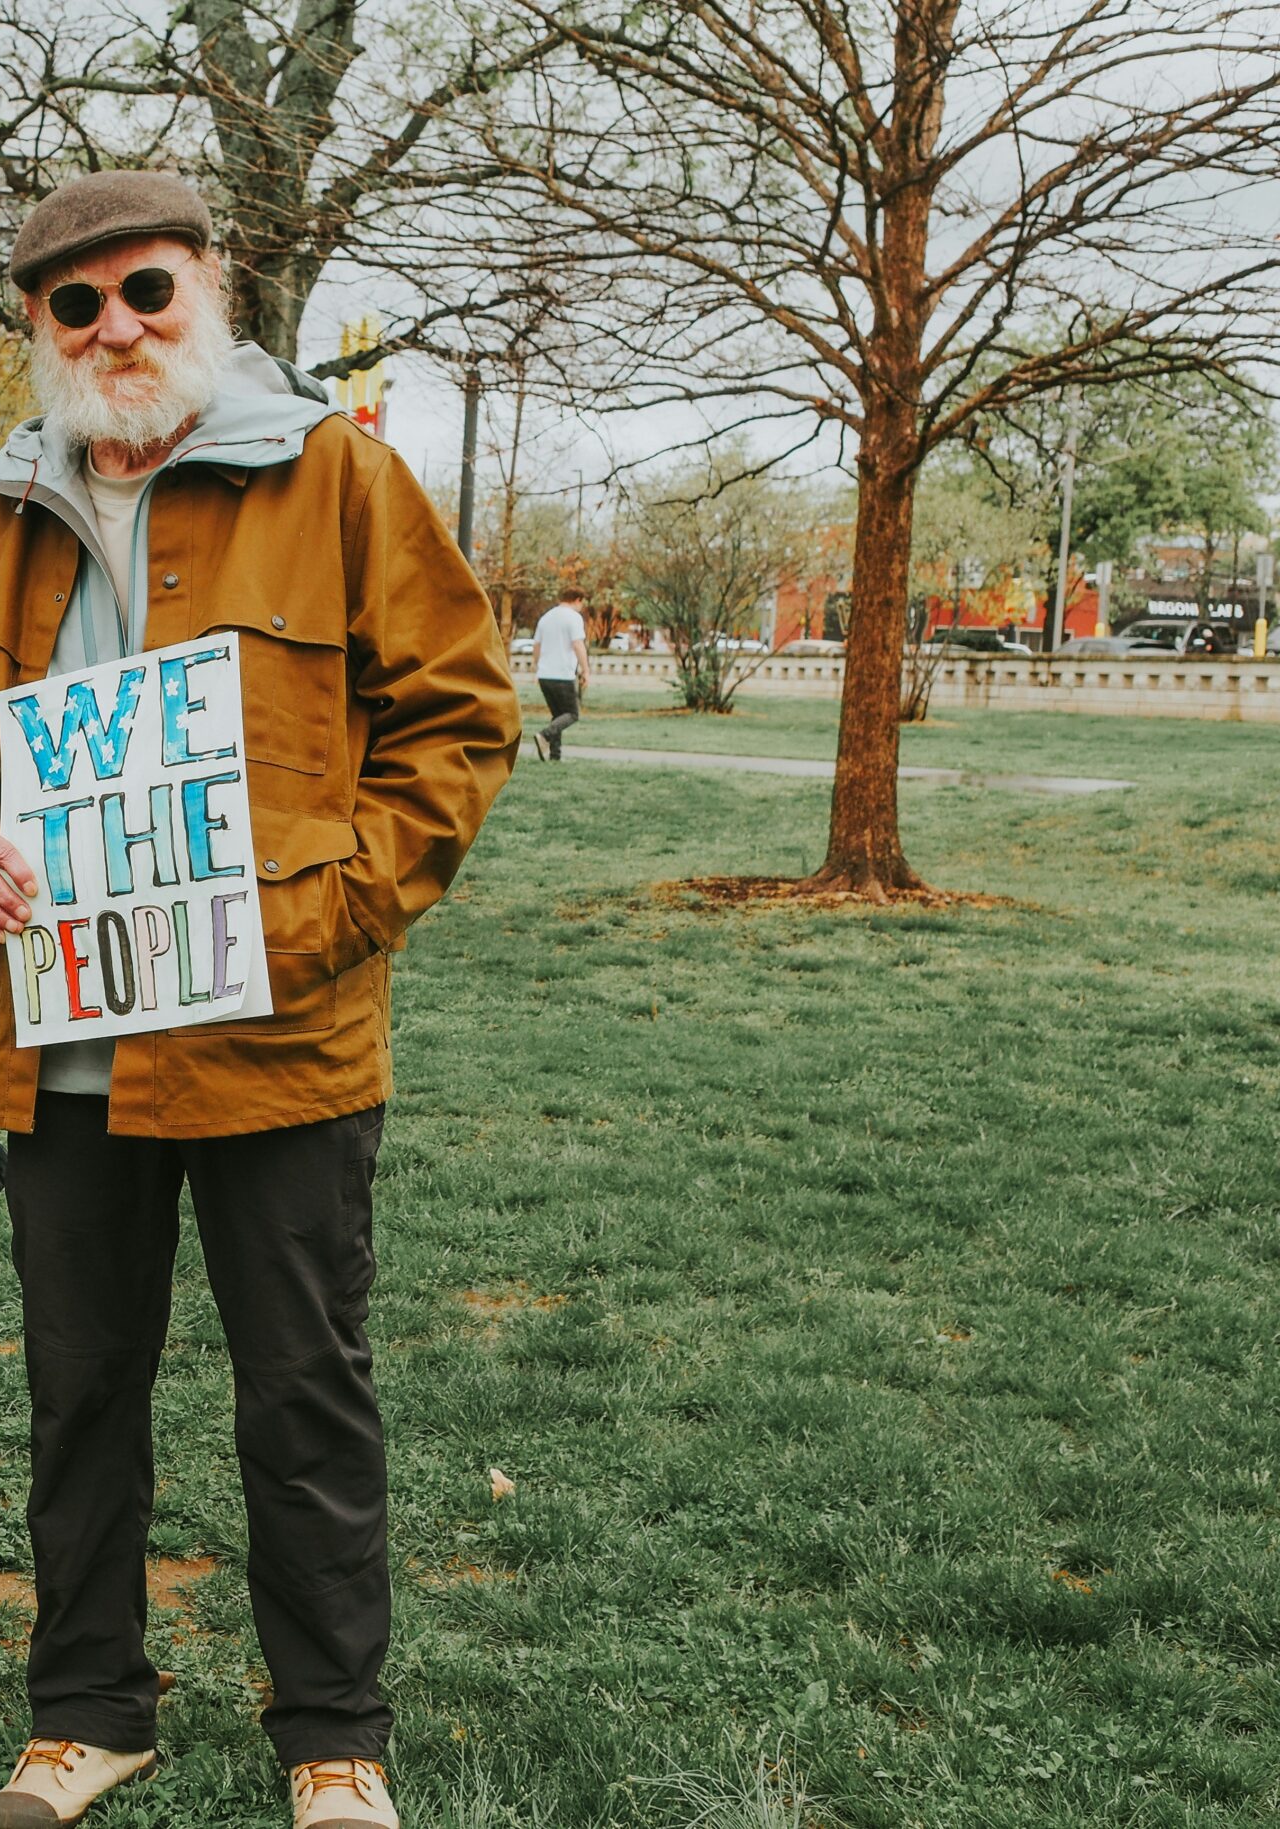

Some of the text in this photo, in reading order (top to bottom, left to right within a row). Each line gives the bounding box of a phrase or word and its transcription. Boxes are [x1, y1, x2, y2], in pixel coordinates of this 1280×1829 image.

[1148, 600, 1200, 617] BEGONI
[8, 646, 238, 792] WE
[16, 770, 246, 907] THE
[20, 890, 249, 1025] PEOPLE
